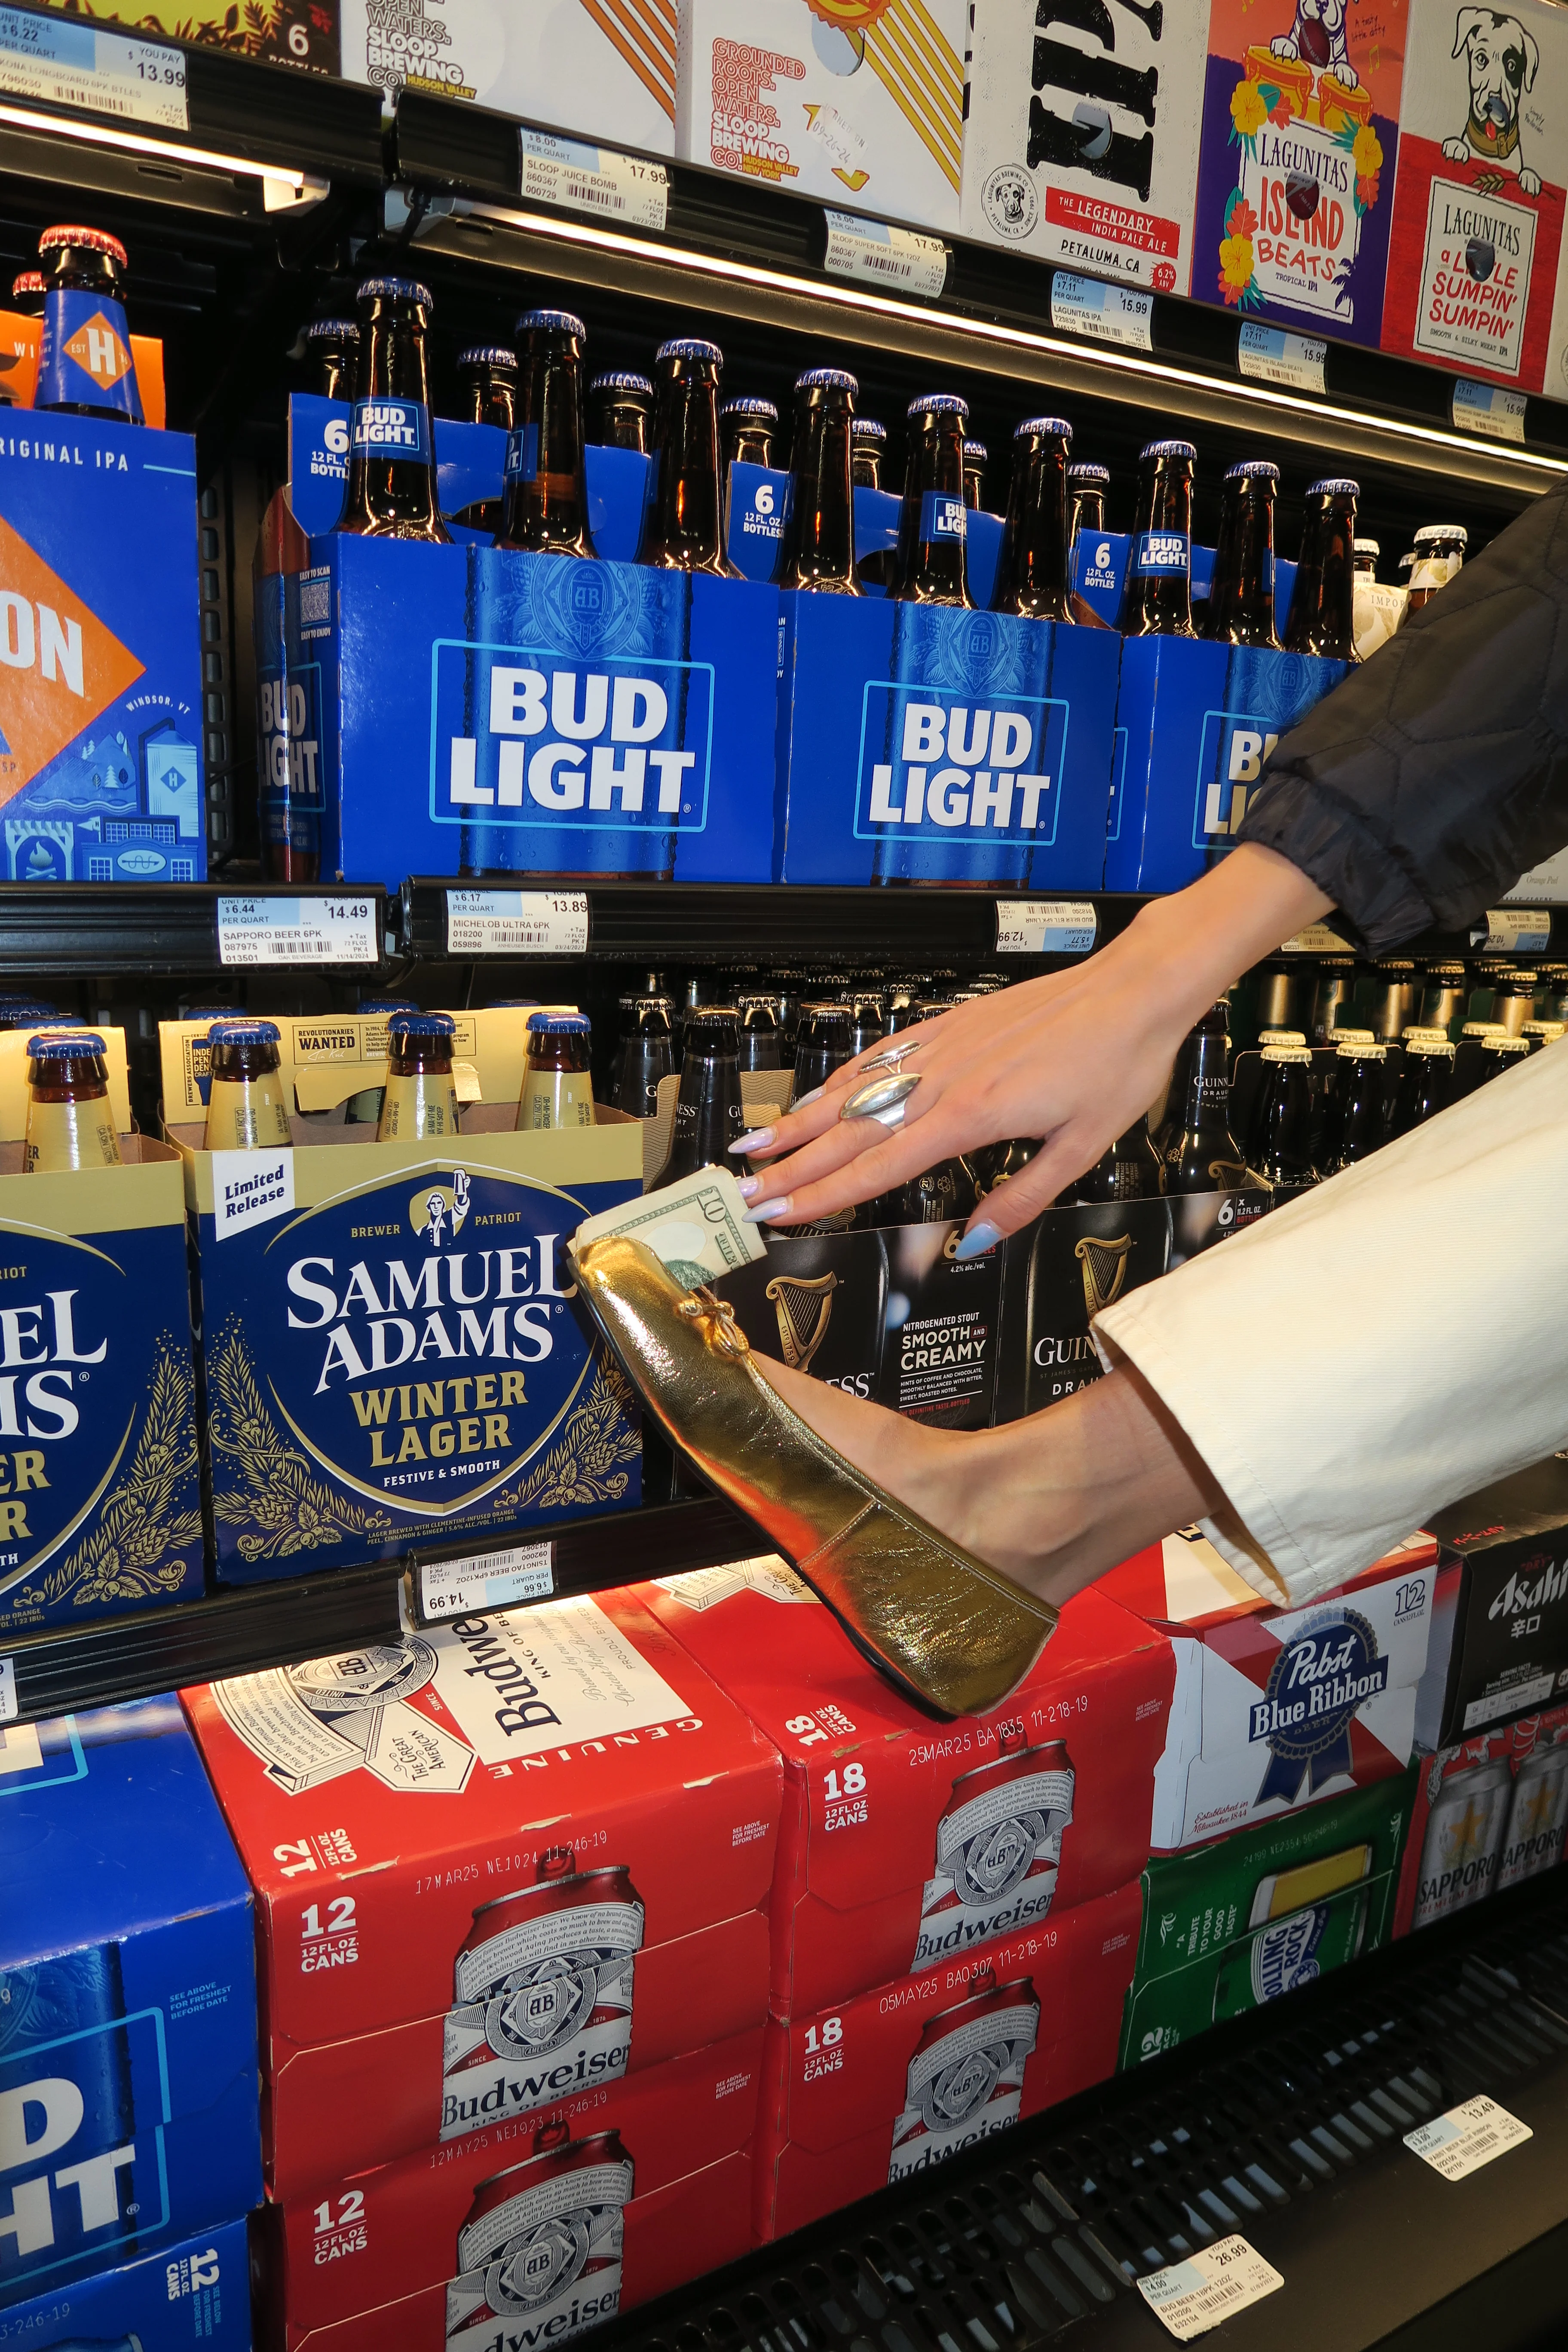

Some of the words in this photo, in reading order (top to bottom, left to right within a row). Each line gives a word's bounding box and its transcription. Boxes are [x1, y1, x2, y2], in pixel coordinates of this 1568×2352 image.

[366, 5, 452, 46] WATERS.
[287, 24, 309, 57] 6
[366, 26, 438, 58] SLOOP
[139, 47, 159, 59] YOU
[161, 52, 181, 64] PAY
[366, 44, 464, 84] BREWING
[712, 37, 806, 80] GROUNDED
[137, 61, 185, 88] 13.99
[712, 57, 776, 91] ROOTS.
[712, 77, 759, 101] OPEN
[712, 92, 781, 129] WATERS.
[711, 111, 770, 140] SLOOP
[710, 129, 790, 163] BREWING
[527, 159, 559, 175] SLOOP
[561, 168, 588, 183] JUICE
[590, 175, 617, 191] BOMB
[630, 164, 667, 185] 17.99
[743, 154, 773, 170] HUDSON
[774, 162, 800, 177] VALLEY
[743, 164, 760, 175] NEW
[760, 168, 781, 182] YORK
[1260, 133, 1348, 193] LAGUNITAS
[525, 185, 557, 200] 000729
[526, 172, 558, 188] 860367
[1059, 196, 1073, 207] THE
[1078, 200, 1154, 233] LEGENDARY
[1091, 223, 1117, 238] INDIA
[1121, 231, 1143, 245] PALE
[1147, 241, 1167, 253] ALE
[1444, 204, 1520, 256] LAGUNITAS
[830, 245, 857, 258] 860367
[832, 233, 853, 245] SLOOP
[854, 238, 875, 251] SUPER
[876, 243, 891, 255] SOFT
[914, 237, 945, 254] 17.99
[1061, 240, 1121, 267] PETALUMA,
[1126, 259, 1139, 272] CA
[1258, 238, 1336, 281] BEATS
[1158, 268, 1174, 280] 6.2%
[1276, 273, 1306, 287] TROPICAL
[1308, 280, 1317, 292] IPA
[1433, 271, 1517, 313] SUMPIN'
[1054, 305, 1090, 318] LAGUNITAS
[1091, 313, 1101, 322] IPA
[1121, 299, 1147, 314] 15.99
[1429, 299, 1514, 339] SUMPIN'
[86, 328, 116, 376] H
[1304, 349, 1325, 363] 15.99
[361, 406, 406, 426] BUD
[323, 419, 349, 454] 6
[353, 425, 414, 445] LIGHT
[96, 450, 129, 471] IPA
[755, 485, 774, 515] 6
[743, 522, 783, 539] BOTTLES
[1094, 542, 1110, 569] 6
[1148, 535, 1183, 554] BUD
[1141, 550, 1187, 567] LIGHT
[300, 571, 310, 582] EASY
[311, 569, 317, 577] TO
[317, 566, 330, 576] SCAN
[1084, 576, 1115, 591] BOTTLES
[126, 695, 174, 713] WINDSOR,
[178, 701, 191, 715] VT
[489, 665, 668, 744] BUD
[901, 702, 1033, 769] BUD
[450, 737, 695, 813] LIGHT
[869, 764, 1051, 829] LIGHT
[328, 905, 368, 919] 14.49
[552, 900, 588, 913] 13.89
[224, 931, 272, 940] SAPPORO
[275, 931, 301, 939] BEER
[453, 919, 500, 928] MICHELOB
[998, 931, 1024, 942] 12.99
[224, 943, 257, 951] 087975
[298, 1036, 355, 1050] WANTED
[224, 1163, 285, 1201] Limited
[225, 1185, 285, 1219] Release
[351, 1223, 400, 1238] BREWER
[475, 1212, 522, 1226] PATRIOT
[950, 1265, 964, 1273] 4.2%
[965, 1262, 985, 1271] alc./vol.
[286, 1233, 578, 1329] SAMUEL
[903, 1316, 956, 1332] NITROGENATED
[958, 1312, 979, 1323] STOUT
[313, 1303, 554, 1396] ADAMS
[902, 1326, 970, 1349] SMOOTH
[901, 1340, 986, 1370] CREAMY
[954, 1368, 982, 1377] CHOCOLATE,
[349, 1371, 529, 1428] WINTER
[368, 1413, 513, 1468] LAGER
[383, 1469, 435, 1487] FESTIVE
[438, 1467, 447, 1478] &
[450, 1460, 501, 1479] SMOOTH
[431, 1514, 491, 1528] CLEMENTINE-INFUSED
[492, 1509, 514, 1517] ORANGE
[511, 1560, 548, 1572] TSINGTAO
[430, 1592, 464, 1609] 14.99
[1395, 1579, 1426, 1617] 12
[1488, 1557, 1568, 1621] Asahi
[1511, 1614, 1540, 1639] 辛口
[1287, 1634, 1358, 1690] Pabst
[1252, 1697, 1307, 1740] Blue
[1308, 1669, 1383, 1718] Ribbon
[909, 1737, 971, 1767] 25MAR25
[1031, 1697, 1089, 1727] 11-218-19
[487, 1718, 704, 1780] GENUINE
[824, 1762, 867, 1801] 18
[744, 1820, 760, 1831] ABOVE
[824, 1808, 868, 1832] CANS
[1188, 1817, 1230, 1837] Milwaukee
[1231, 1810, 1246, 1821] 1844
[1194, 1802, 1239, 1824] Established
[732, 1835, 752, 1846] BEFORE
[753, 1830, 765, 1839] DATE
[744, 1823, 769, 1836] FRESHEST
[546, 1829, 608, 1862] 11-246-19
[1418, 1854, 1496, 1906] SAPPORO
[301, 1896, 356, 1939] 12
[914, 1892, 1054, 1962] Budweiser
[301, 1948, 359, 1972] CANS
[804, 2017, 843, 2055] 18
[803, 2058, 843, 2082] CANS
[443, 2043, 631, 2128] Budweiser
[1216, 2244, 1247, 2266] 26.99
[1160, 2303, 1176, 2313] BUD
[1177, 2293, 1197, 2306] BEER
